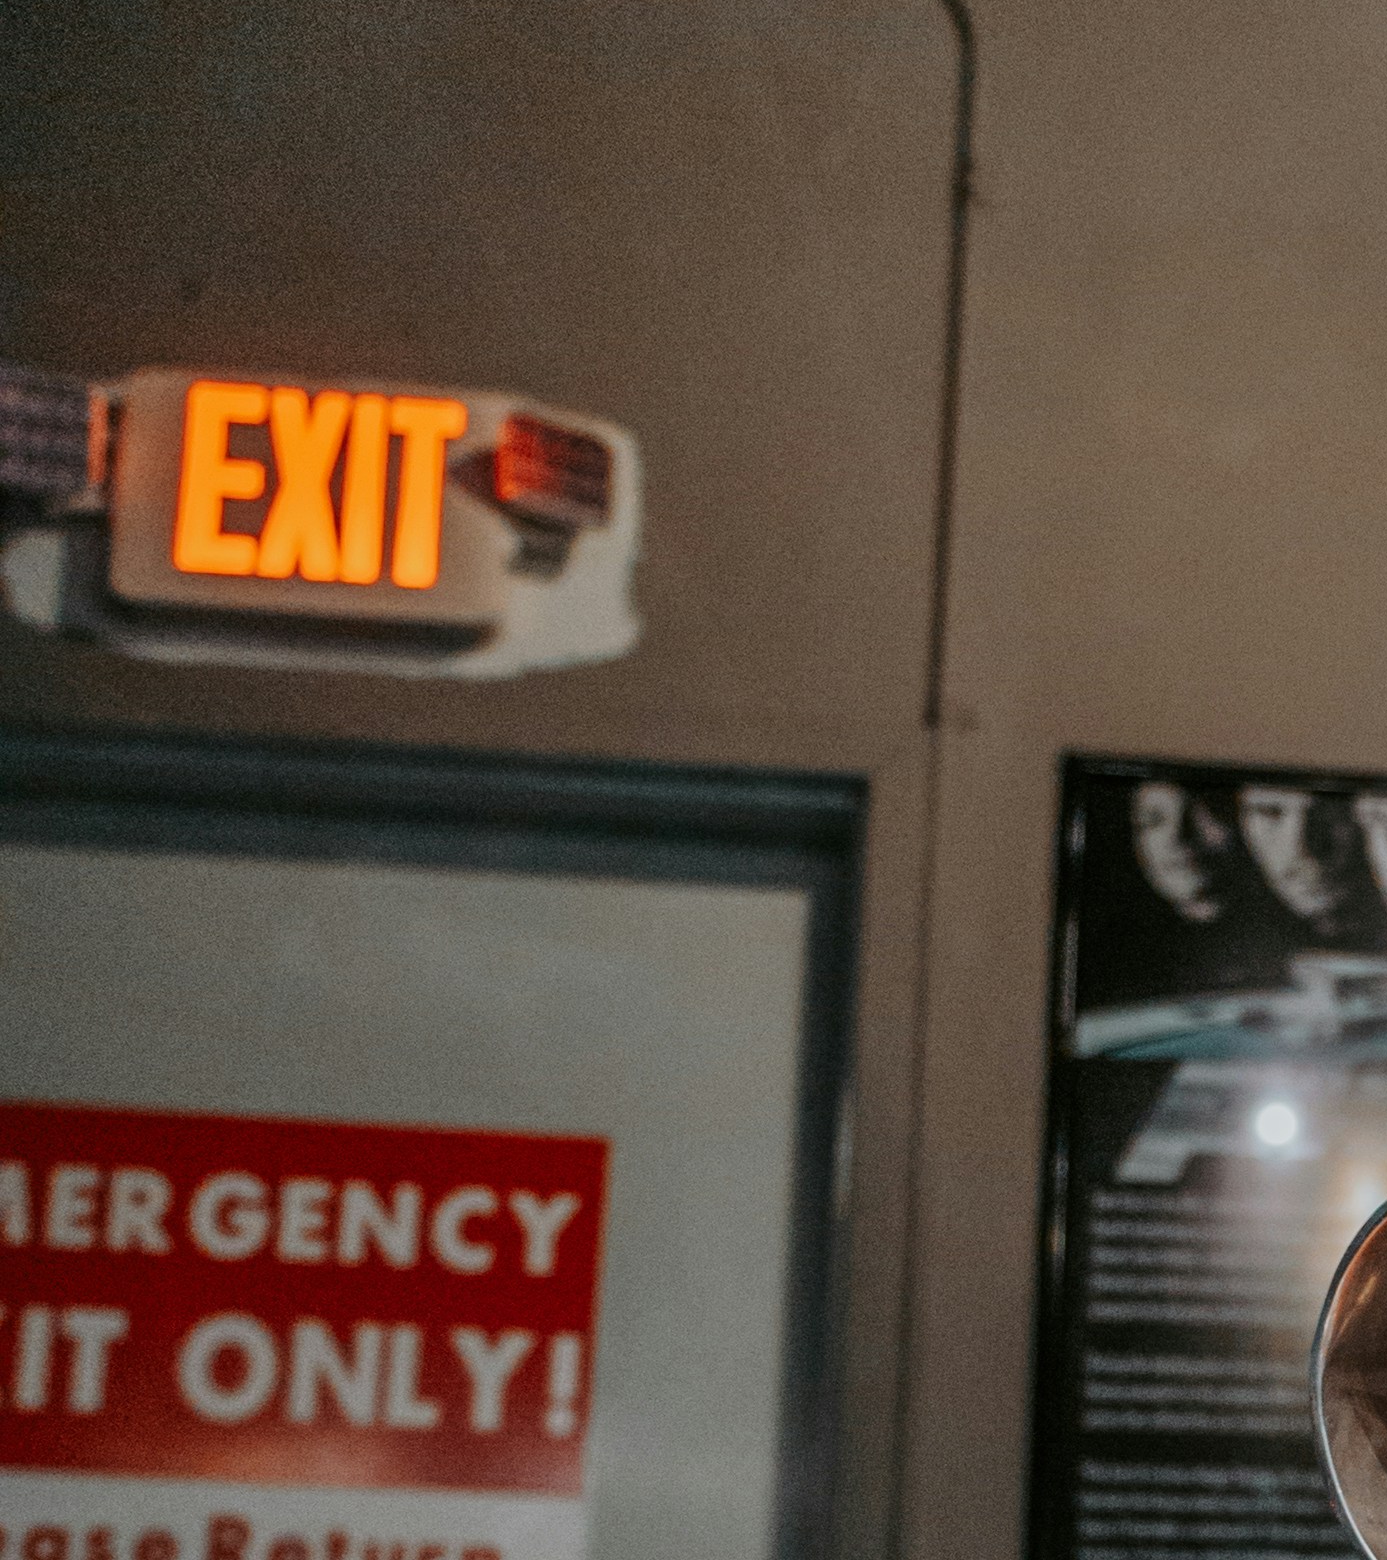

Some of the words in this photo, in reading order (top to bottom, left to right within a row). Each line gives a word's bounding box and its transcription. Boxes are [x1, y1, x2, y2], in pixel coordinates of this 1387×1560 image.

[172, 380, 469, 589] EXIT
[0, 1306, 130, 1414] IT
[176, 1312, 583, 1438] ONLY!
